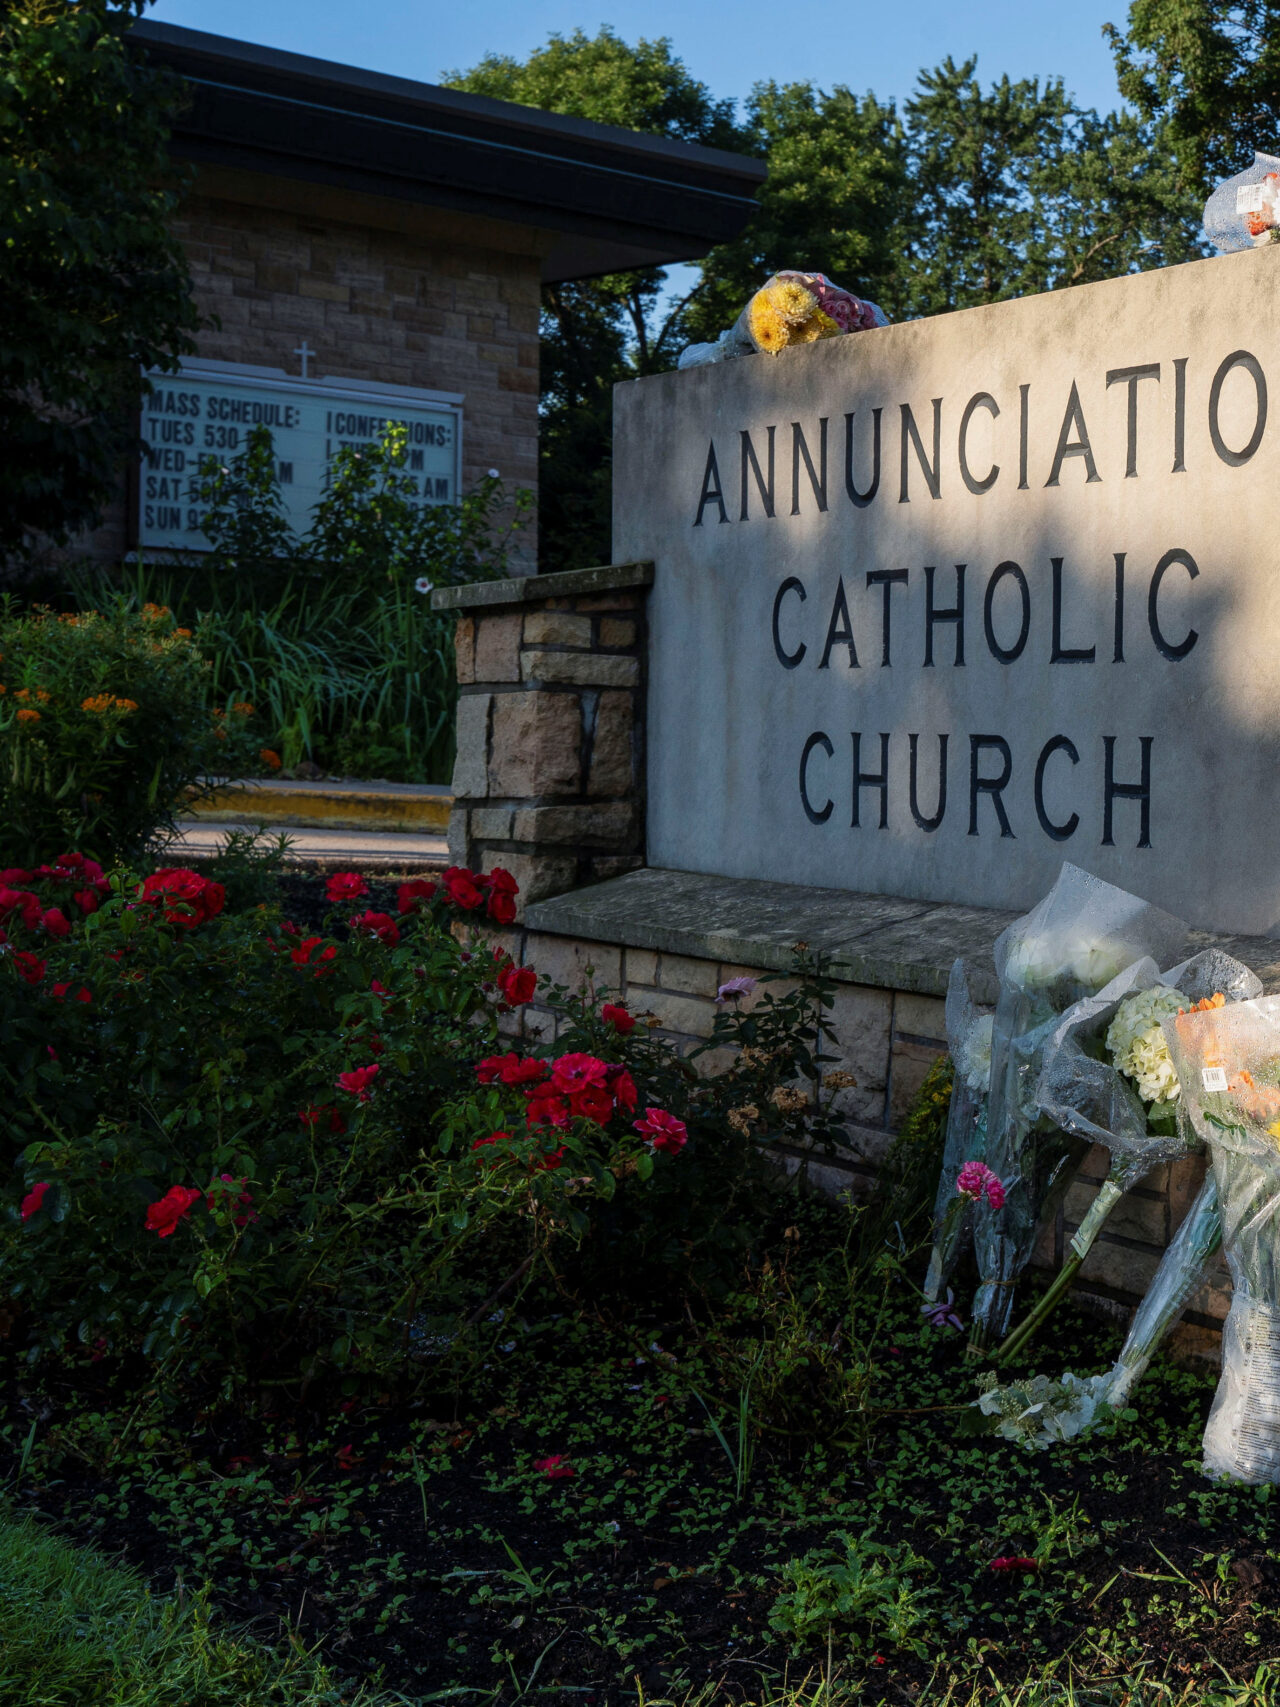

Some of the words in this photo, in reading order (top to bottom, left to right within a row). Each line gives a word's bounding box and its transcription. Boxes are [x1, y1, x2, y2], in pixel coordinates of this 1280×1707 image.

[148, 390, 200, 417] MASS
[207, 396, 300, 428] SCHEDULE:
[147, 418, 195, 445] TUES
[204, 424, 238, 449] 530
[335, 412, 452, 447] CONFEIONS:
[146, 475, 182, 501] SAT
[423, 477, 449, 500] AM
[145, 504, 181, 530] SUN
[772, 547, 1200, 669] CATHOLIC
[800, 731, 1155, 849] CHURCH
